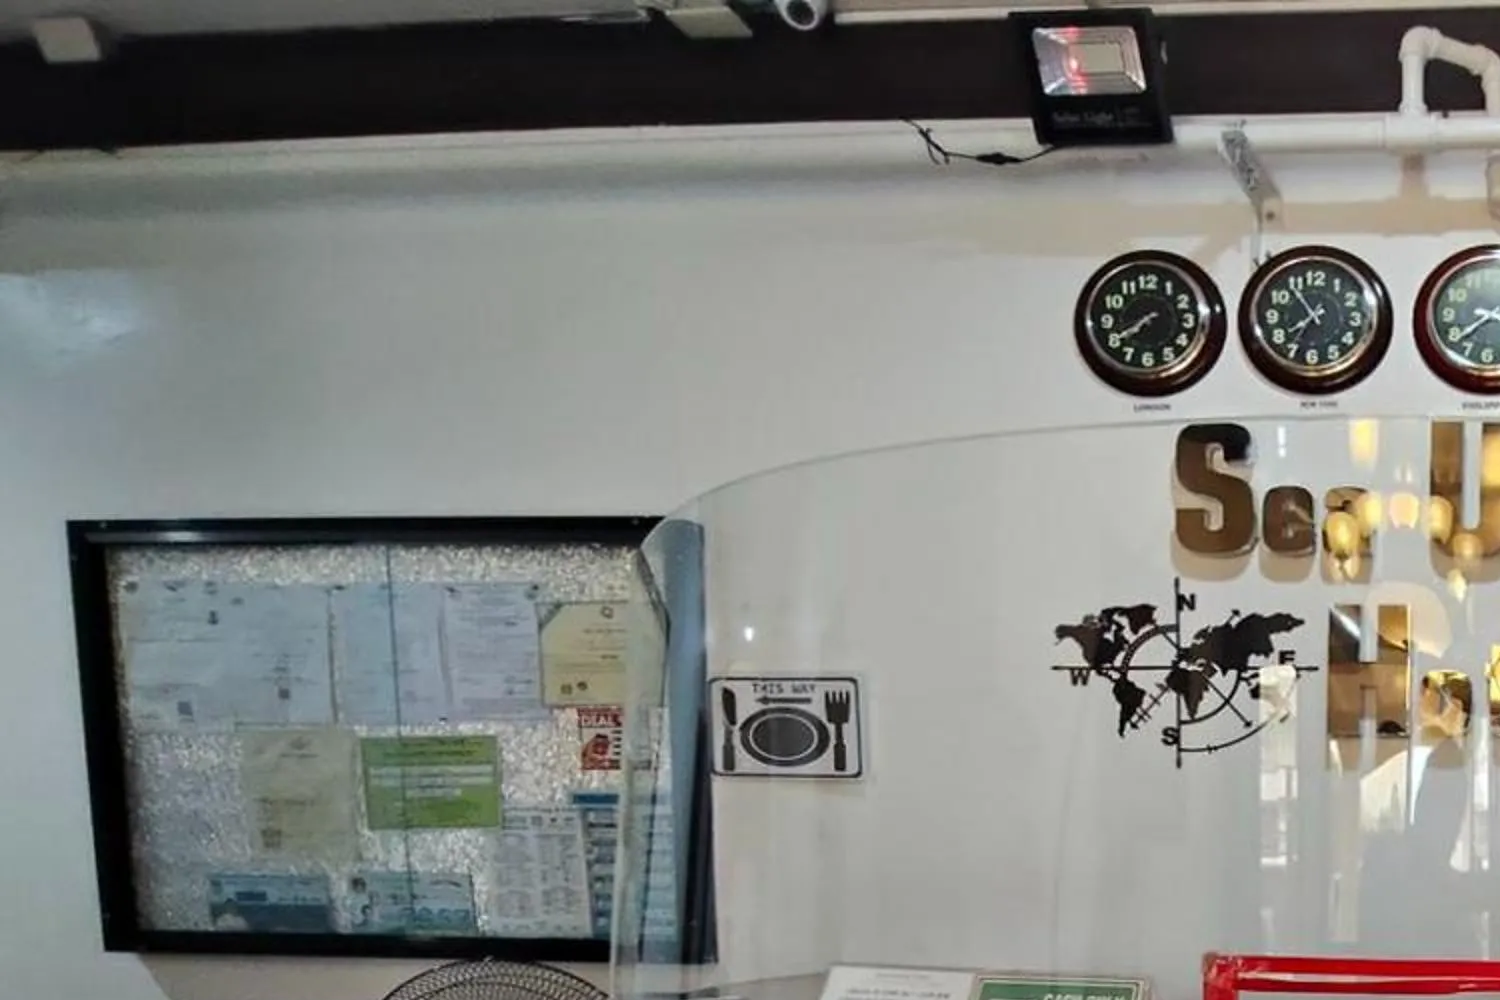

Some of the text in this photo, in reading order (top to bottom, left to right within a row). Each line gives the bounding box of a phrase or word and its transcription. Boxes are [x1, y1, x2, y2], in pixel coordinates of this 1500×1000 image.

[1138, 275, 1158, 289] 12
[1289, 276, 1302, 290] 11
[1306, 271, 1325, 286] 12
[1334, 278, 1340, 293] 1
[1122, 281, 1136, 294] 11
[1166, 281, 1173, 295] 1
[1105, 295, 1123, 309] 10
[1177, 295, 1189, 309] 2
[1272, 290, 1289, 304] 10
[1345, 292, 1357, 307] 2
[1448, 288, 1467, 302] 10
[1101, 315, 1113, 328] 9
[1183, 313, 1194, 328] 3
[1266, 310, 1279, 324] 9
[1350, 312, 1361, 326] 3
[1443, 308, 1455, 322] 9
[1108, 334, 1121, 348] 8
[1176, 334, 1188, 346] 4
[1273, 329, 1285, 344] 8
[1342, 332, 1354, 345] 4
[1449, 327, 1461, 342] 8
[1123, 348, 1134, 362] 7
[1163, 348, 1174, 361] 5
[1288, 344, 1299, 358] 7
[1328, 345, 1338, 359] 5
[1463, 343, 1473, 356] 7
[1481, 348, 1493, 362] 6
[1142, 352, 1154, 367] 6
[1306, 350, 1318, 364] 6
[1175, 423, 1374, 558] Sea
